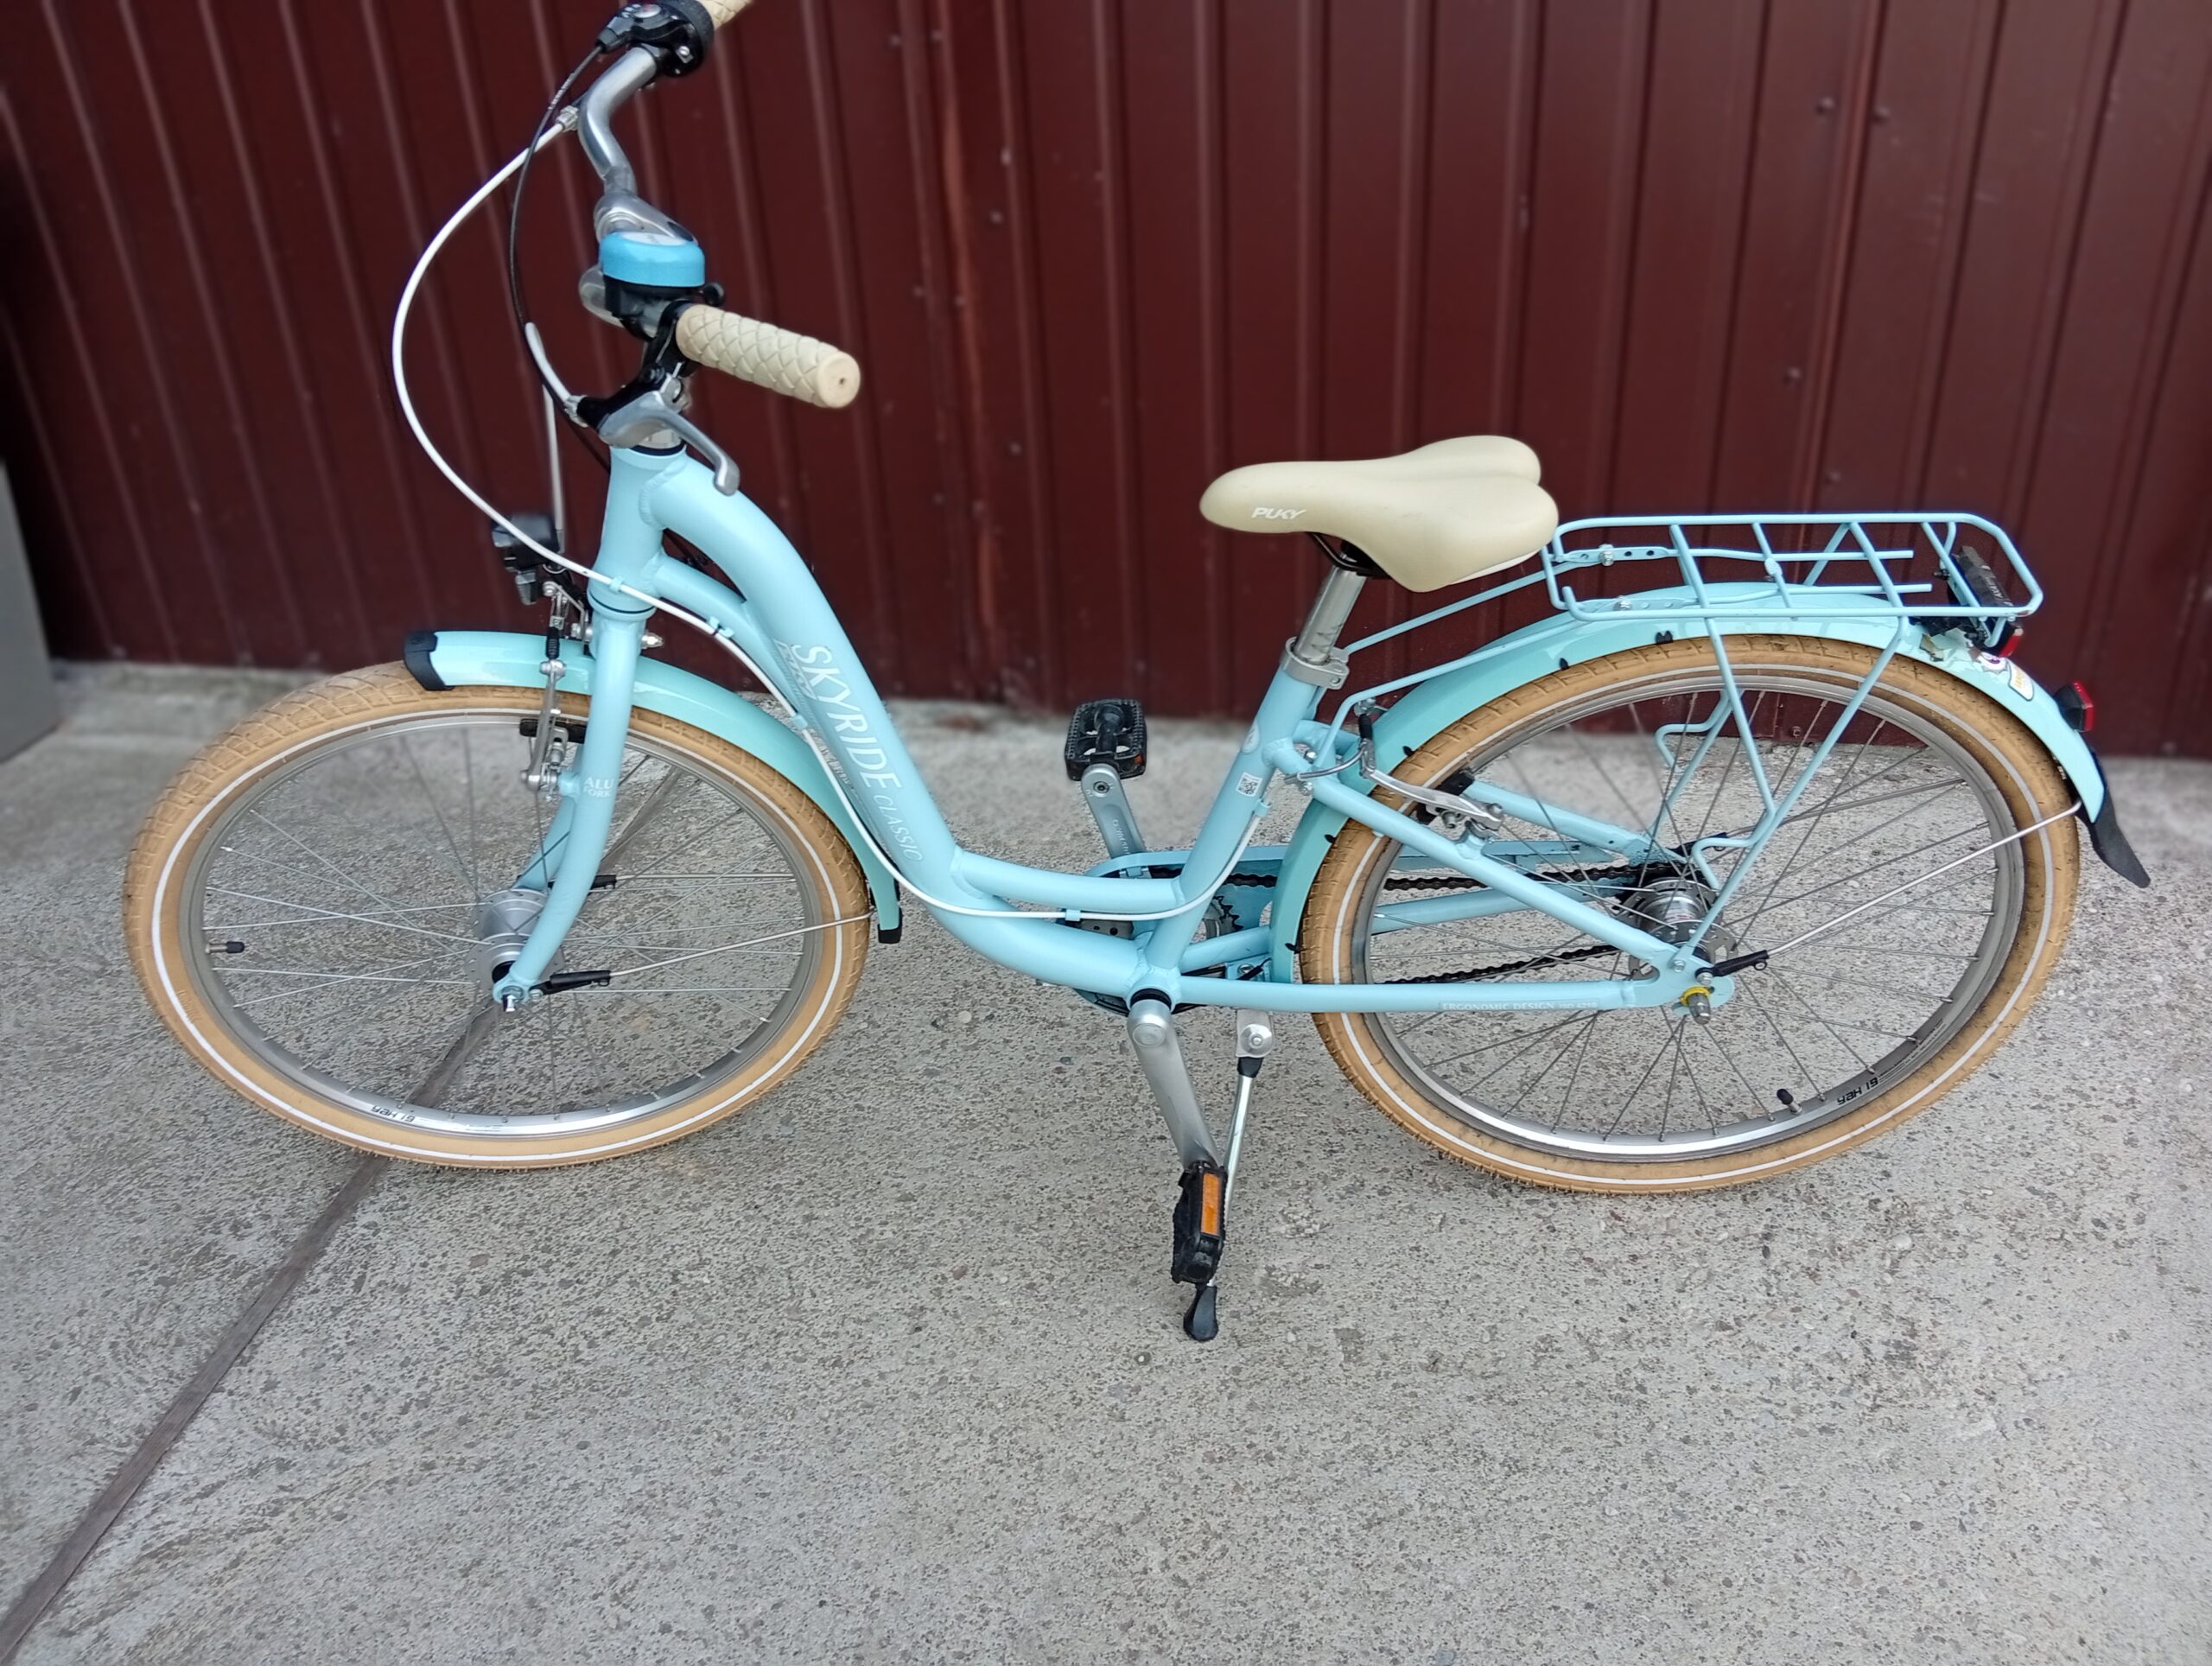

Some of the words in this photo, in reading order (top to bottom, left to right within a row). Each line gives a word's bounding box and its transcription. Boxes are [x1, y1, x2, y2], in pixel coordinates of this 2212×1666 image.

[1250, 506, 1307, 520] PUKY
[791, 644, 902, 789] SKYRIDE
[874, 793, 924, 862] CLASSIC
[583, 777, 615, 790] ALU
[1442, 1002, 1510, 1011] ERGONOMIC
[1512, 1002, 1556, 1010] DESIGN
